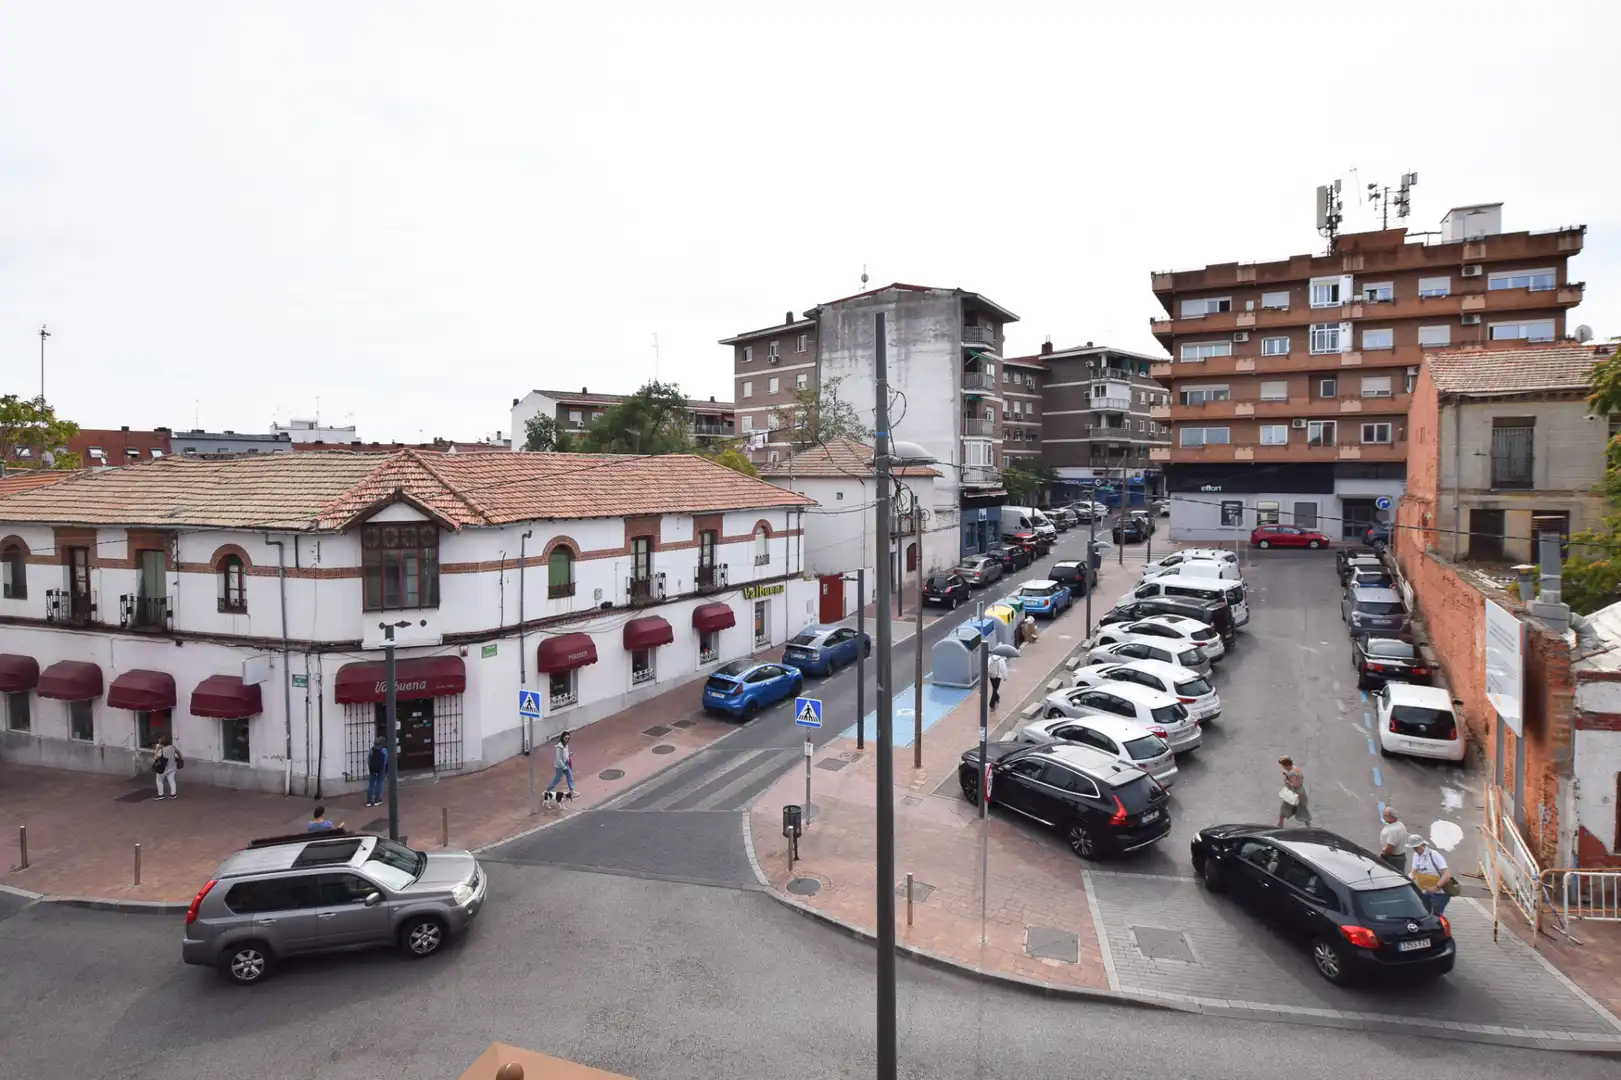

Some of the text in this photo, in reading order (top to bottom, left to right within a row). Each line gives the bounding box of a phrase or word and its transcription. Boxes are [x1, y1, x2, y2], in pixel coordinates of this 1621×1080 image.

[1200, 484, 1222, 492] effort
[743, 584, 784, 600] Valbuena
[374, 680, 427, 693] Vabuena
